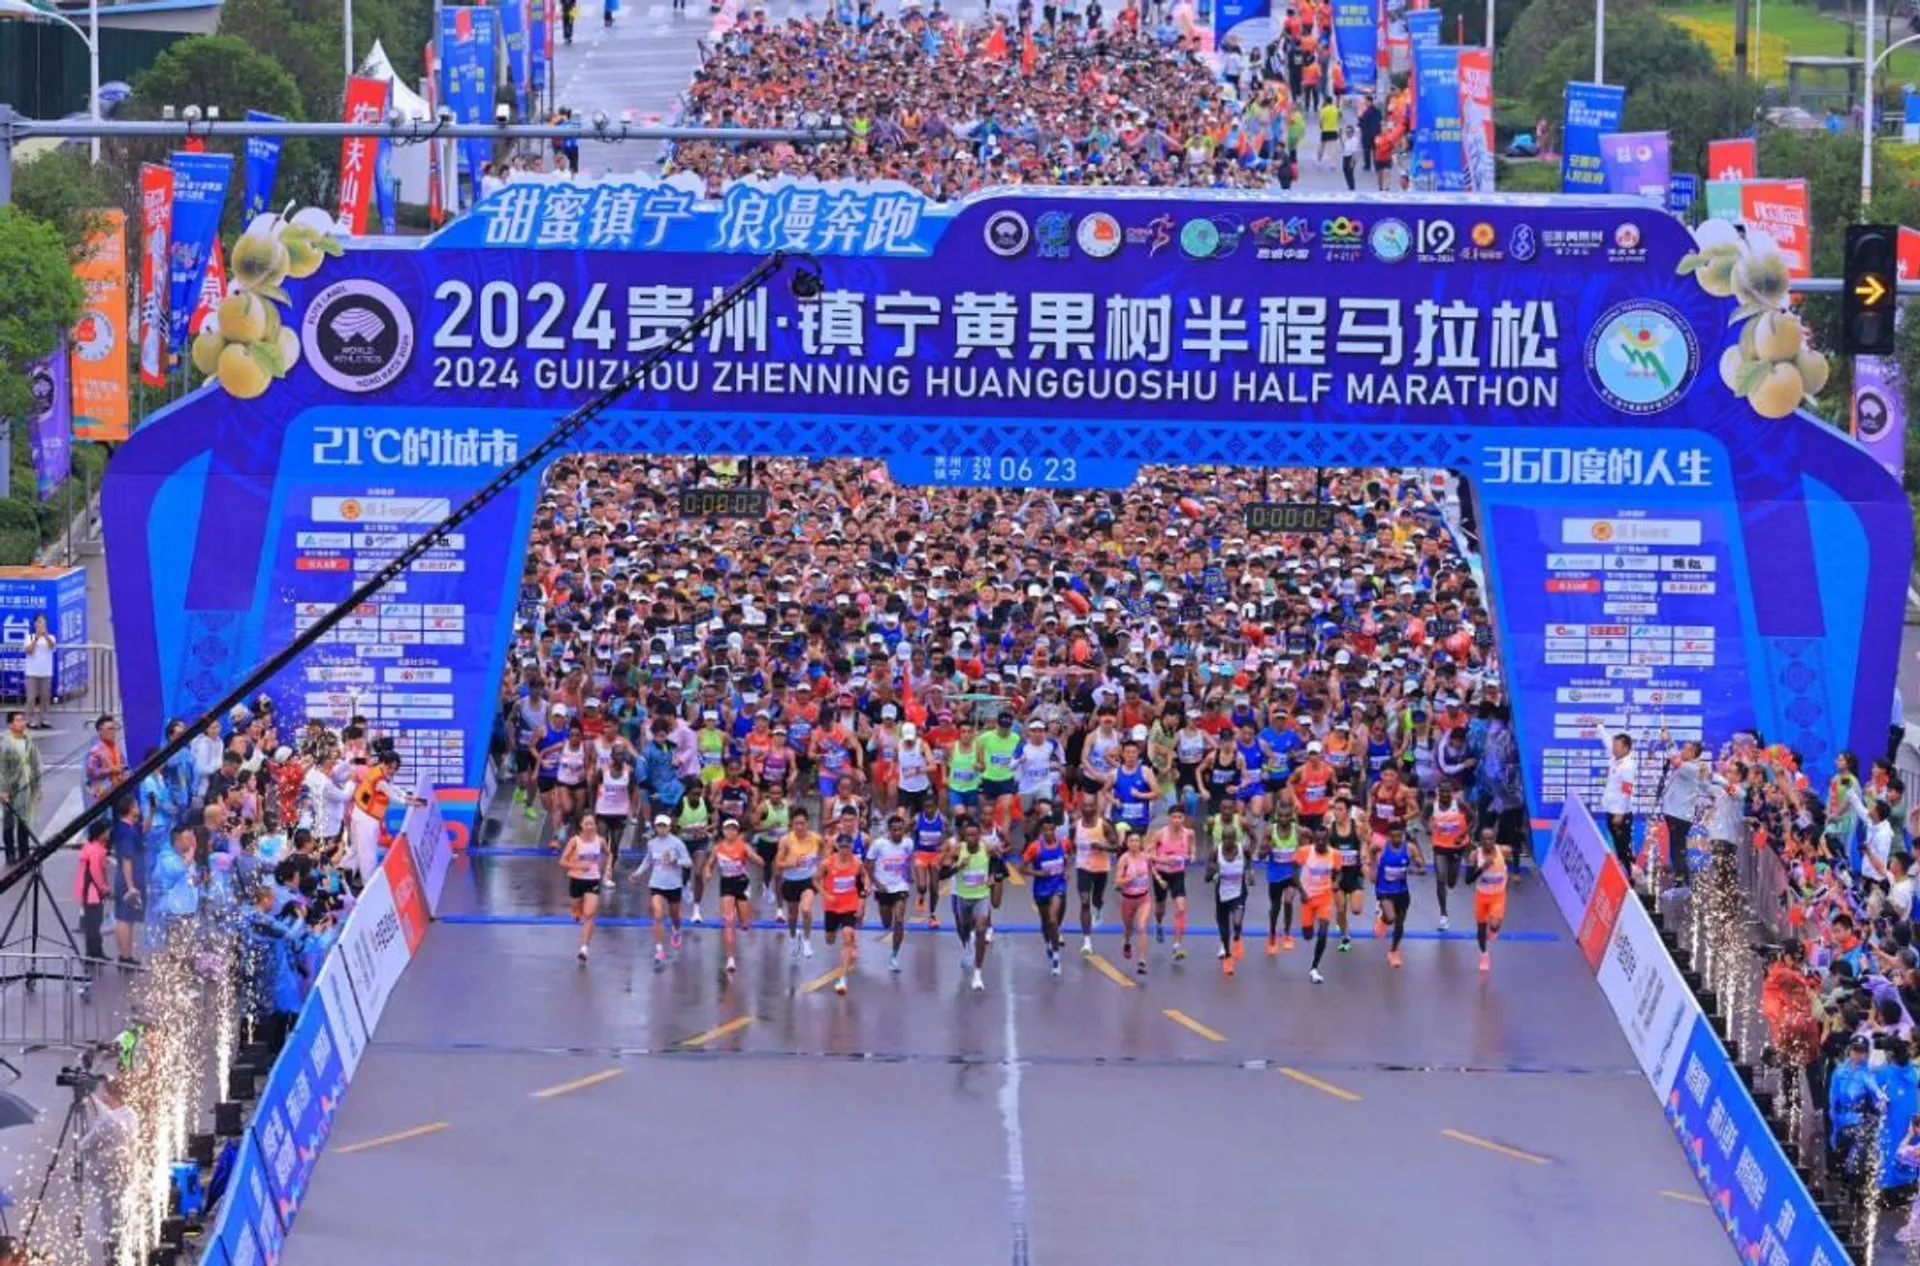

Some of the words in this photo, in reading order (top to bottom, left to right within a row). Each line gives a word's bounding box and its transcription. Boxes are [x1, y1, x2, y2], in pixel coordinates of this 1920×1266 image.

[477, 186, 696, 245] 甜蜜镇宁
[713, 190, 929, 253] 浪漫奔跑
[433, 357, 519, 388] 2024
[712, 361, 911, 396] ZHENNING
[926, 365, 1219, 402] HUANGGUOSHU
[1234, 371, 1333, 403] HALF
[1346, 373, 1558, 407] MARATHON
[1000, 457, 1033, 482] 06
[1044, 458, 1077, 482] 23
[1482, 446, 1712, 488] 360度的人生
